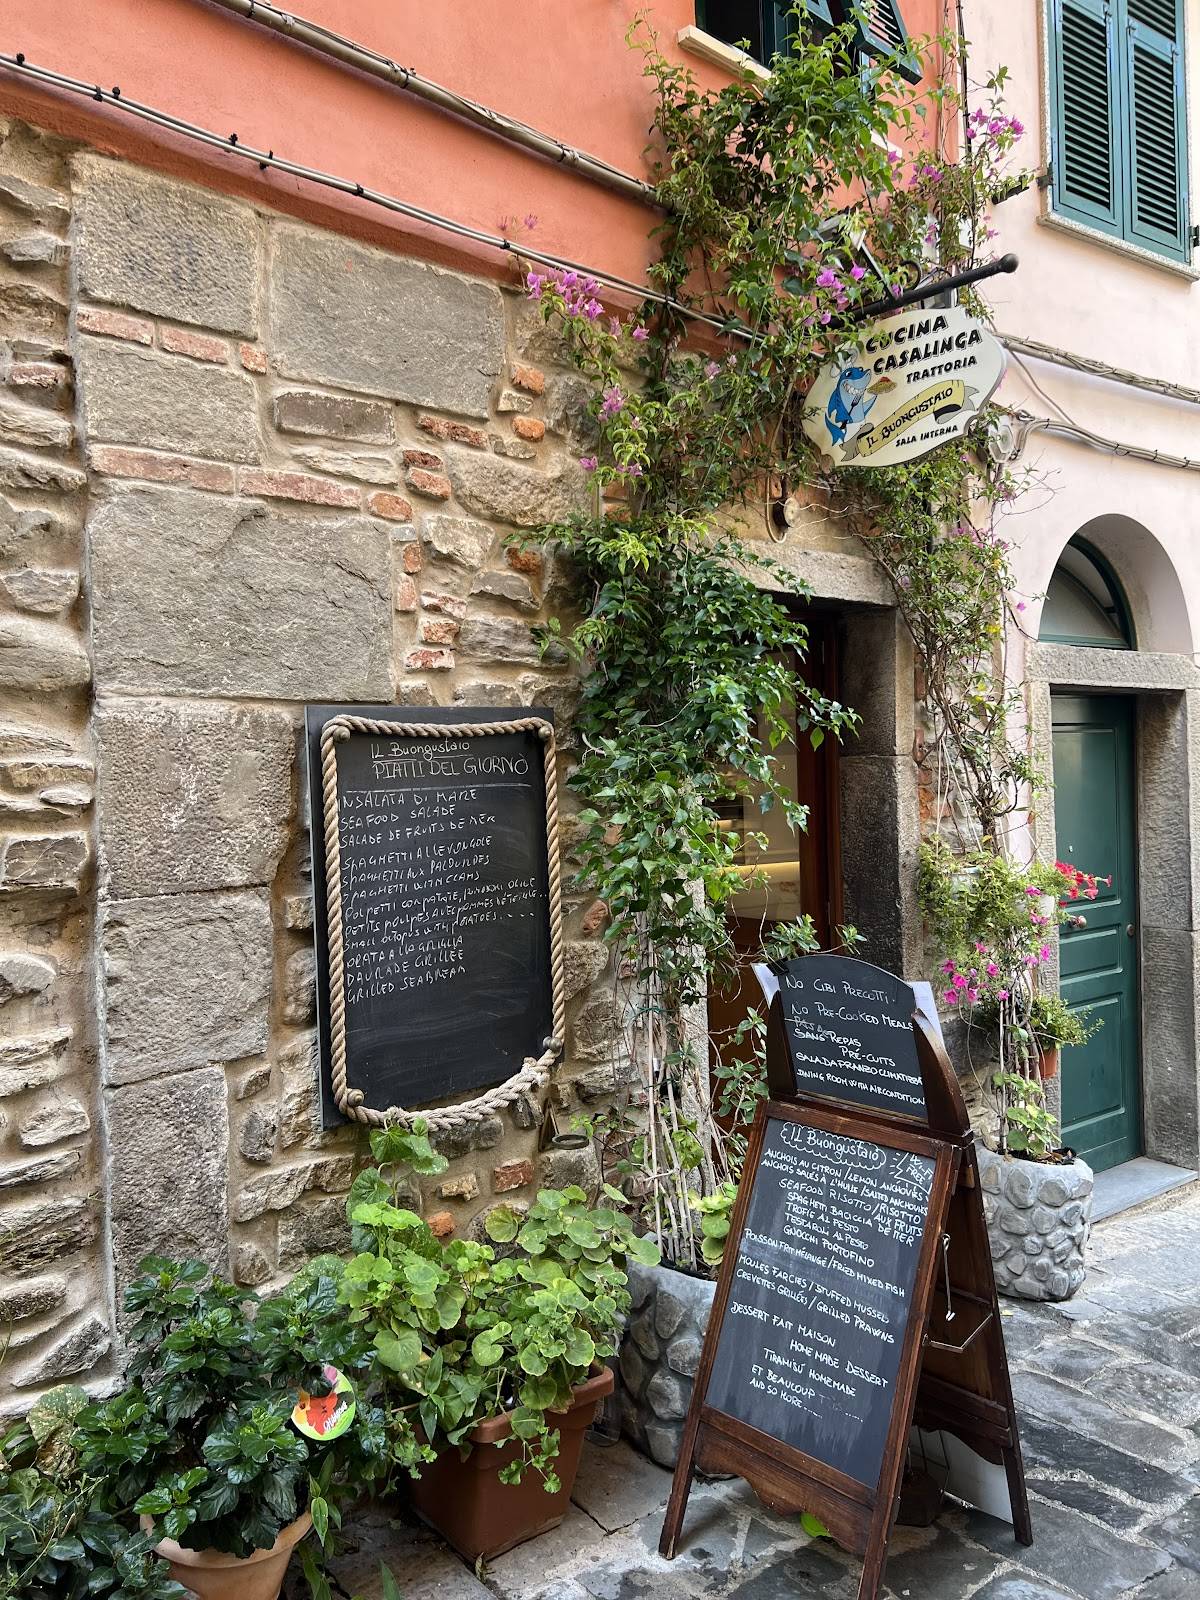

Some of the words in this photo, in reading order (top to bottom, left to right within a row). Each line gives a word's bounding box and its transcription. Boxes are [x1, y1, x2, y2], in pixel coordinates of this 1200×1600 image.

[865, 315, 948, 354] CUCINA
[873, 329, 982, 375] CASALINGA
[906, 355, 978, 384] TRATTORIA
[895, 435, 917, 447] SALA
[920, 425, 958, 441] INTERNA
[371, 760, 426, 780] PIATTI
[429, 760, 460, 776] DEL
[338, 790, 405, 812] INSALATA
[436, 788, 478, 803] MARE
[339, 832, 382, 849] SALADE
[388, 829, 401, 841] DE
[405, 822, 445, 839] FRUITS
[449, 817, 465, 830] DE
[469, 813, 496, 826] MER
[347, 982, 396, 1004] GRILLED
[785, 974, 804, 989] NO
[791, 1000, 809, 1015] NO
[881, 1013, 914, 1032] MEALS
[793, 1028, 826, 1042] SANS
[826, 1030, 862, 1048] REPAS
[796, 1068, 825, 1082] DINING
[825, 1072, 848, 1087] ROOM
[761, 1159, 795, 1174] ANCHOIS
[764, 1148, 798, 1166] ANCHOIS
[811, 1163, 842, 1178] CITRON
[779, 1178, 824, 1196] SEAFOOD
[829, 1188, 872, 1212] RISOTTO
[785, 1201, 815, 1219] TROFIE
[816, 1213, 831, 1224] AL
[832, 1218, 860, 1234] PESTO
[873, 1213, 893, 1228] AUX
[894, 1218, 923, 1237] FRUITS
[783, 1225, 819, 1245] GNOCCHI
[821, 1237, 876, 1268] PORTOFINO
[877, 1222, 892, 1236] DE
[892, 1229, 915, 1247] MER
[738, 1254, 770, 1275] MOULES
[772, 1265, 808, 1288] FARCIES
[744, 1228, 778, 1248] POISSON
[856, 1271, 884, 1289] MIXED
[884, 1281, 905, 1298] FISH
[730, 1301, 770, 1323] DESSERT
[772, 1314, 794, 1331] FAIT
[797, 1323, 836, 1348] MAISON
[853, 1314, 895, 1343] PRAWNS
[789, 1338, 814, 1357] HOME
[814, 1349, 840, 1369] MADE
[844, 1360, 889, 1388] DESSERT
[749, 1377, 766, 1390] AND
[766, 1384, 778, 1396] SO
[751, 1364, 764, 1377] ET
[766, 1368, 816, 1400] BEAUCOUP
